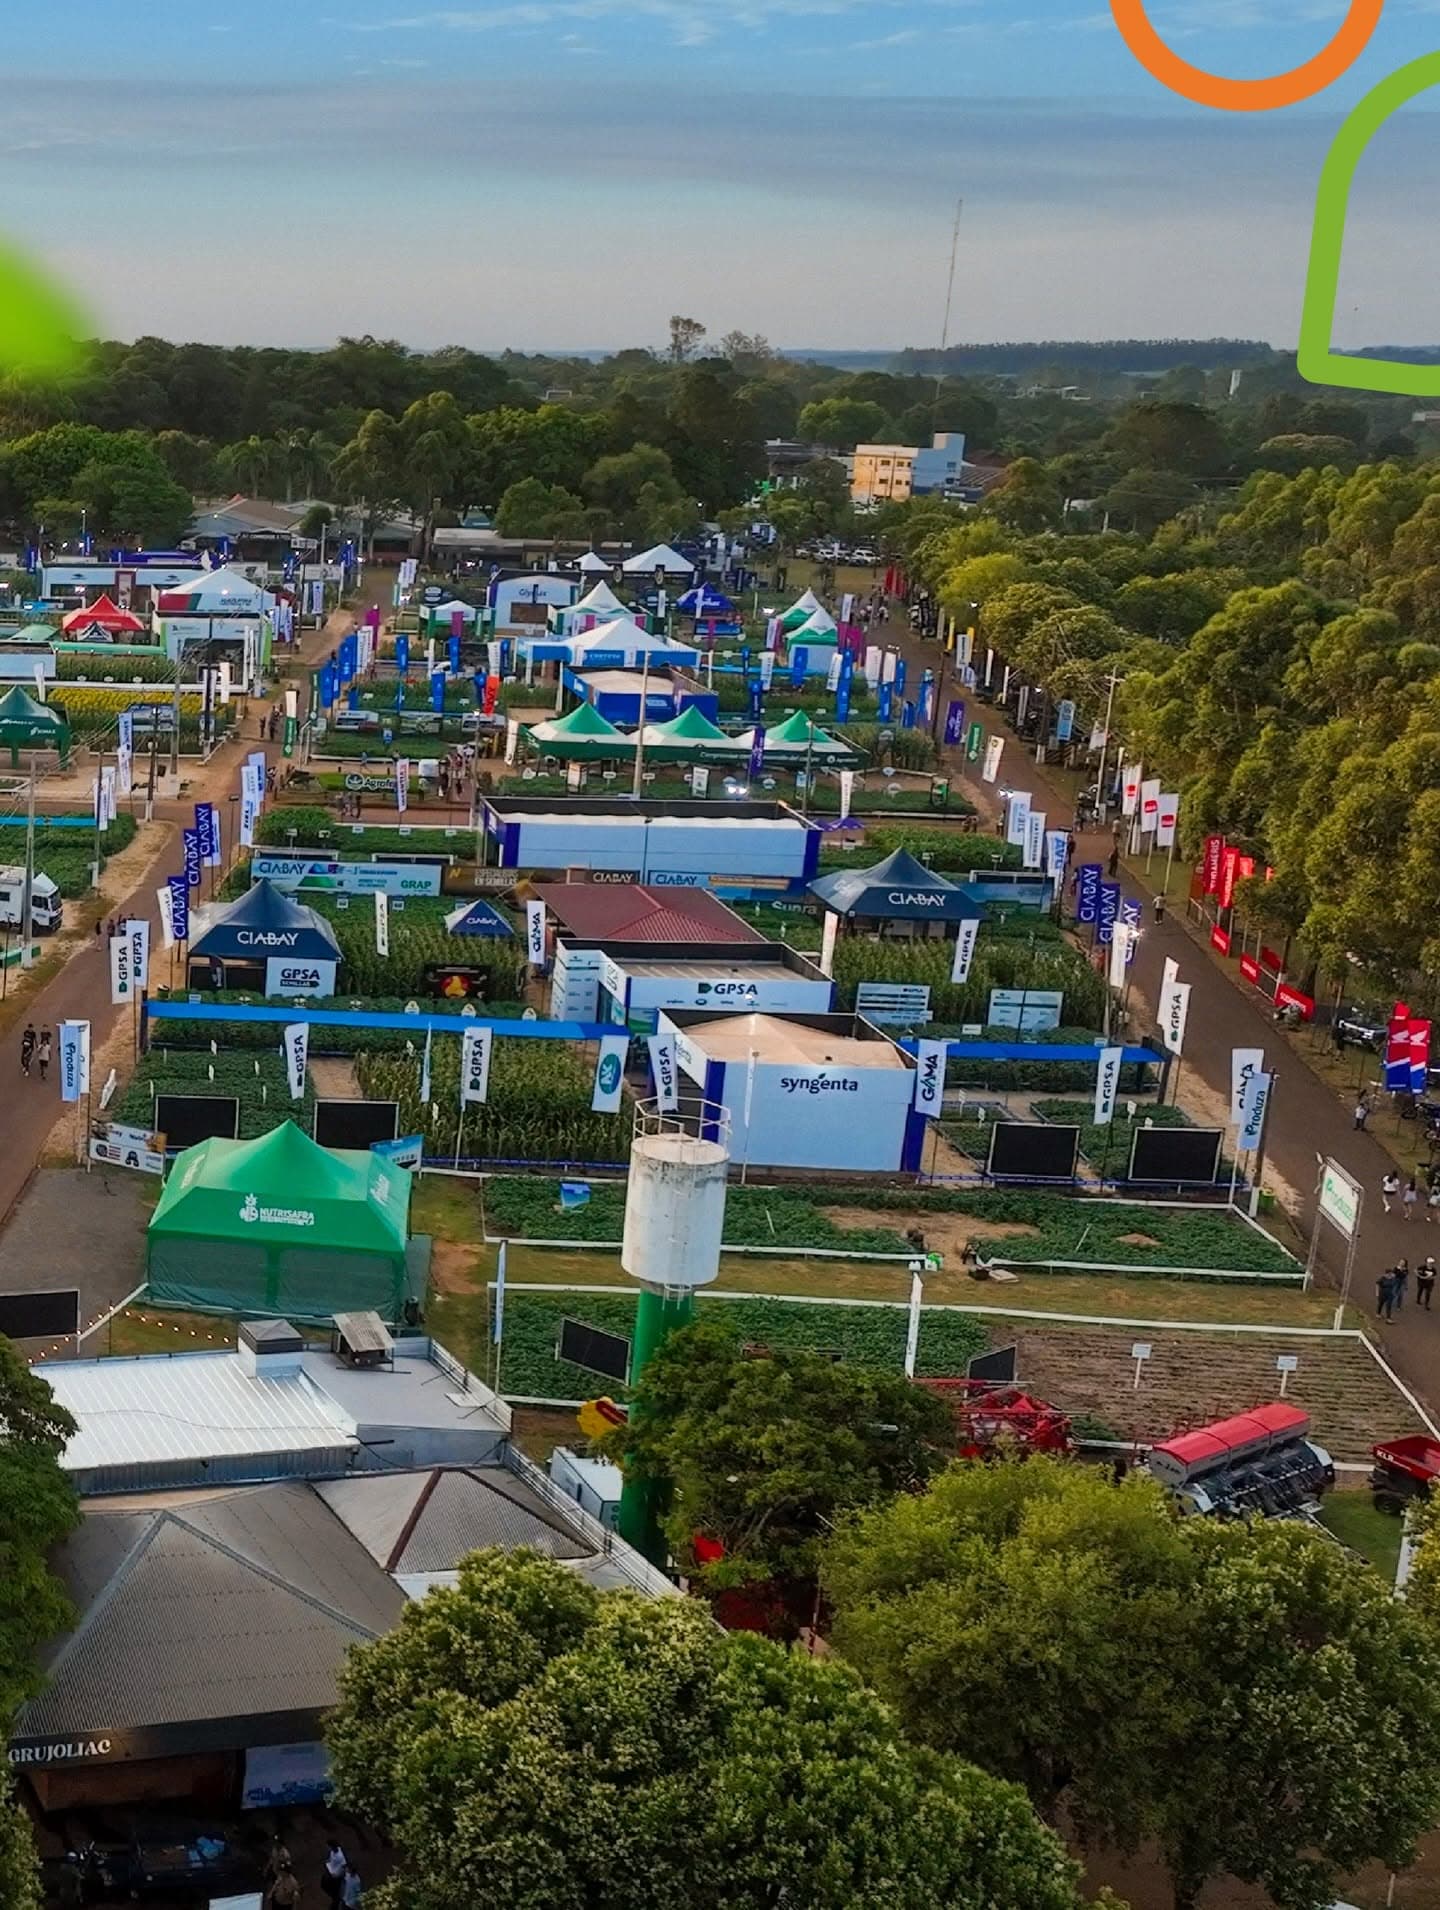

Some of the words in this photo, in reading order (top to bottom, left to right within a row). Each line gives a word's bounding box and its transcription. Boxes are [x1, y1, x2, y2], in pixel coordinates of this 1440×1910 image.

[200, 806, 211, 857] CIABAY
[188, 831, 200, 885] CIABAY
[259, 862, 305, 875] CIABAY
[401, 879, 432, 890] GRAP
[592, 872, 634, 883] CIABAY
[655, 874, 697, 886] CIABAY
[1079, 868, 1098, 921] CIABAY
[173, 880, 187, 939] CIABAY
[888, 892, 946, 908] CIABAY
[1099, 887, 1116, 944] CIABAY
[134, 932, 142, 967] GPSA
[237, 931, 299, 946] CIABAY
[119, 946, 128, 981] GPSA
[281, 968, 320, 981] GPSA
[714, 983, 758, 996] GPSA
[1171, 992, 1182, 1031] GPSA
[65, 1042, 76, 1087] Produza
[294, 1035, 303, 1073] GPSA
[471, 1039, 484, 1077] GPSA
[658, 1046, 671, 1088] GPSA
[780, 1076, 858, 1094] syngenta
[922, 1053, 938, 1101] GAMA
[1103, 1060, 1114, 1098] GPSA
[1246, 1090, 1265, 1136] Produza
[1377, 1449, 1394, 1462] KLR
